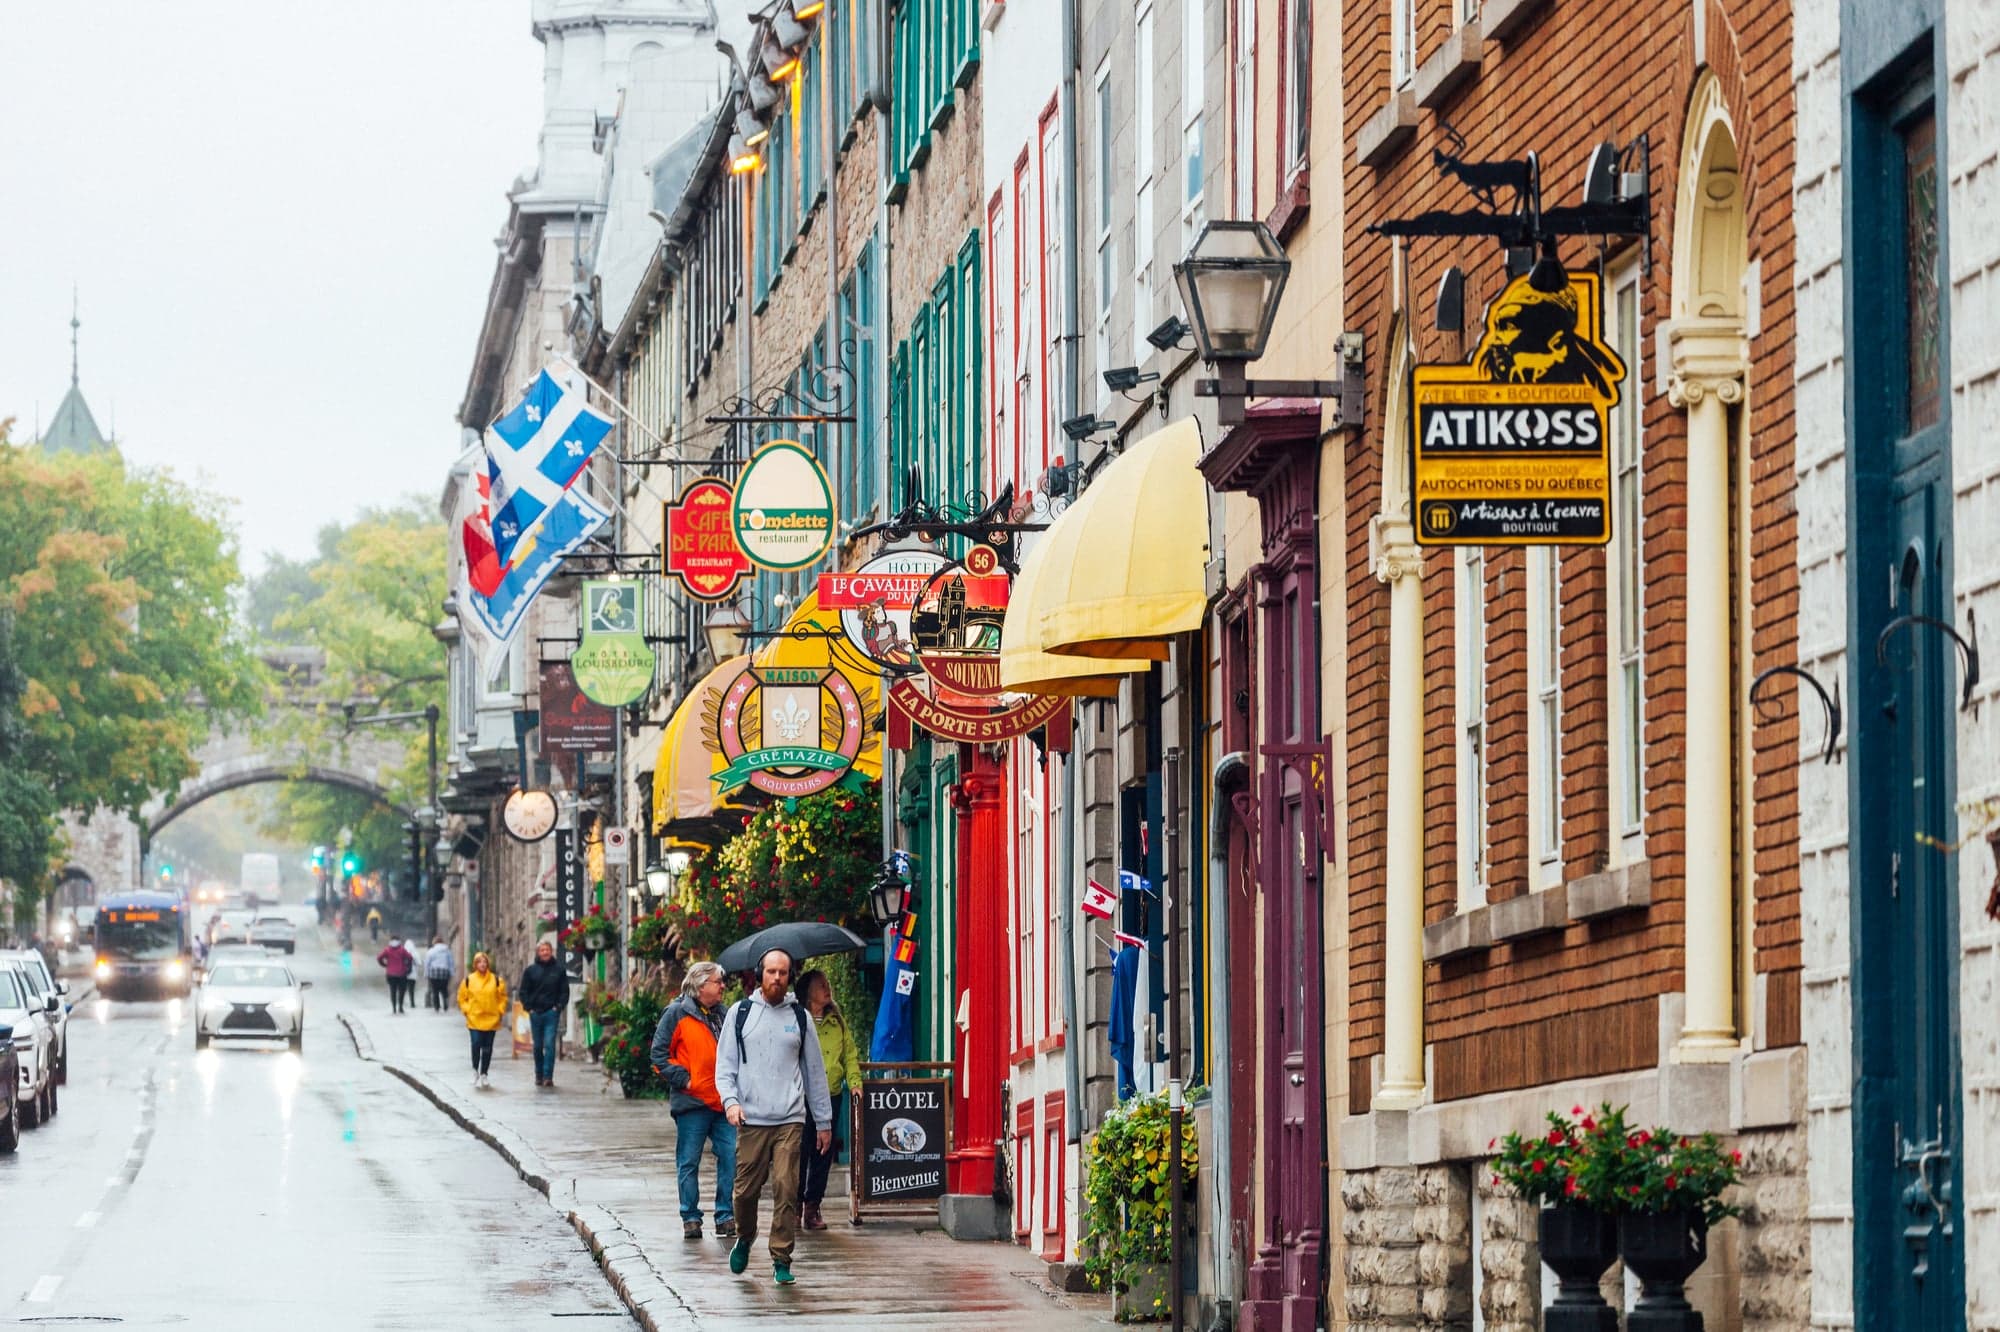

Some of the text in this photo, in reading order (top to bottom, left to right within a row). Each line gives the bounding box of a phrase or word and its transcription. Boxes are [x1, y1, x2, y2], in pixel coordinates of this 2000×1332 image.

[1422, 387, 1593, 402] ATELIER BOUTIQUE
[1425, 409, 1598, 446] ATIKOSS
[1421, 476, 1604, 491] AUTOCHTONES DU QUÉBEC
[1460, 501, 1527, 520] Artisans
[1530, 503, 1541, 519] à
[1502, 522, 1559, 533] BOUTIQUE
[673, 534, 694, 552] DE
[759, 533, 809, 543] restaurant
[687, 558, 733, 567] RESTAURANT
[974, 554, 989, 569] 56
[832, 578, 848, 594] LE
[887, 592, 901, 600] DU
[576, 657, 653, 669] LOUISBOURG
[765, 671, 818, 683] MAISON
[945, 662, 1000, 689] SOUVENI
[898, 687, 917, 711] LA
[920, 706, 977, 736] PORTE
[748, 749, 833, 766] CRÉMAZIE
[760, 777, 822, 791] SOUVENIRS
[870, 1088, 939, 1109] HÔTEL
[872, 1170, 940, 1192] Bienvenue
